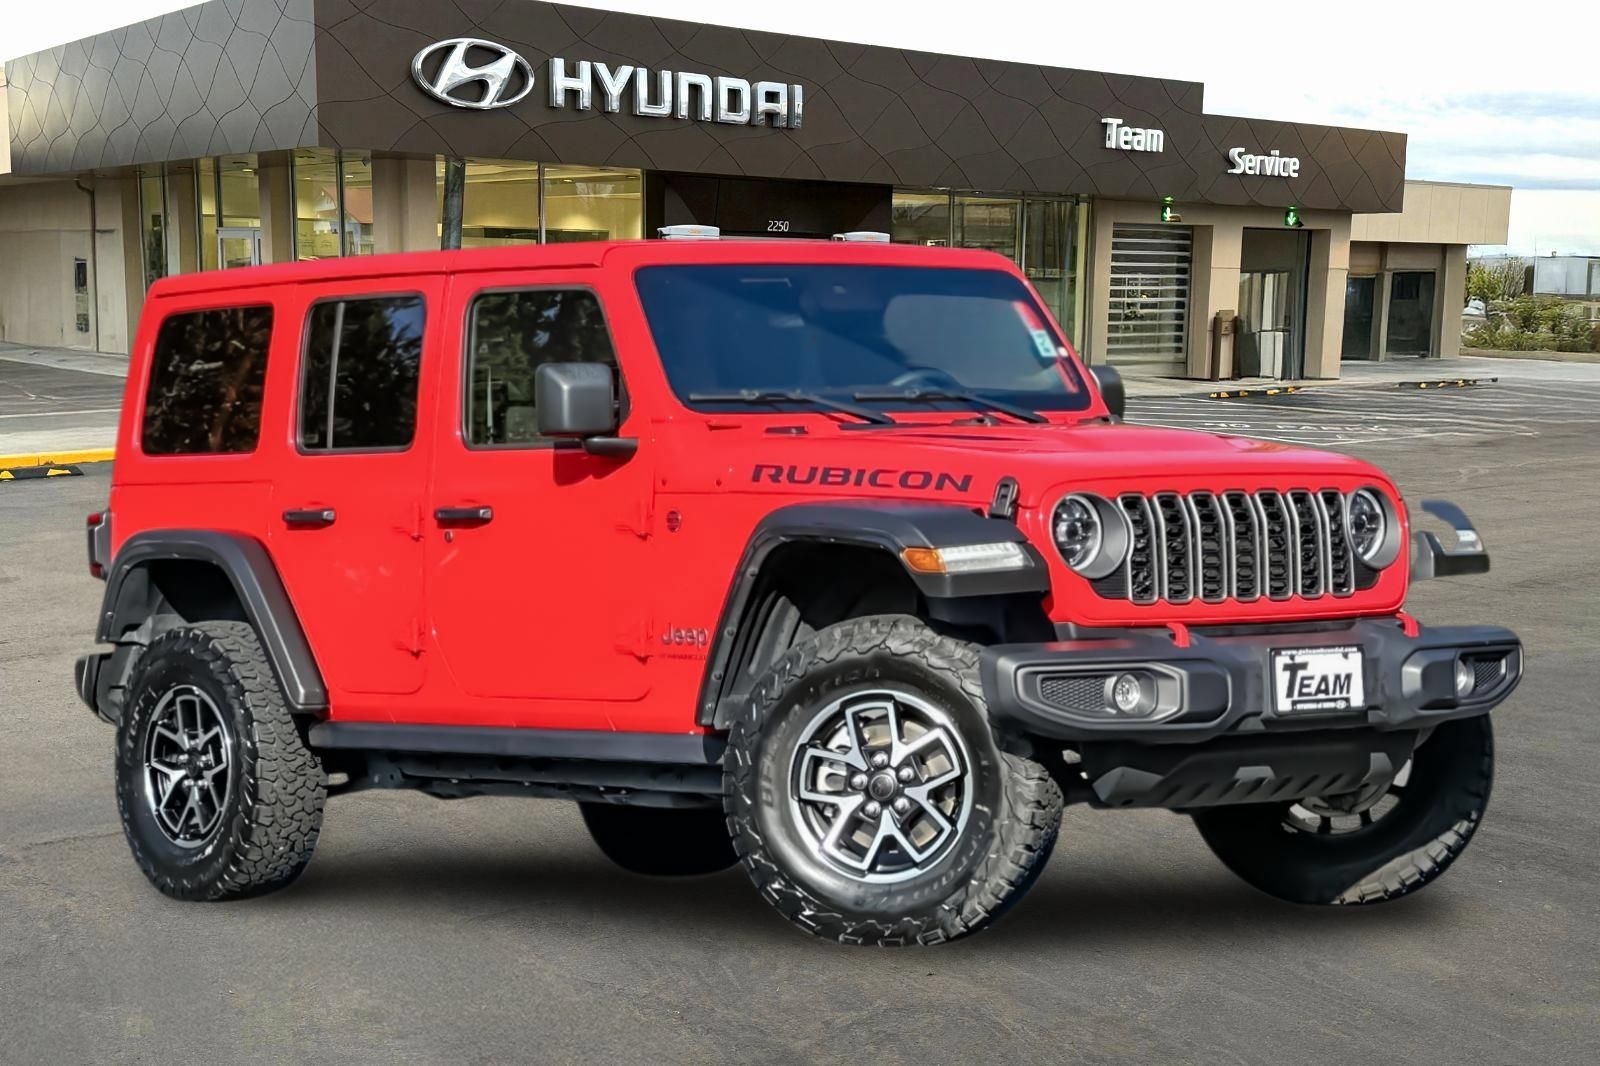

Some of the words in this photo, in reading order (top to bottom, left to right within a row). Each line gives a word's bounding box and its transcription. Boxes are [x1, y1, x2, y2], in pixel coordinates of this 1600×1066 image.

[548, 56, 804, 129] HYUNDAI
[1100, 116, 1165, 153] Team
[1227, 146, 1301, 178] Service
[766, 219, 790, 233] 2250
[751, 463, 973, 493] RUBICON
[662, 622, 709, 649] Jeep
[1282, 661, 1353, 699] TEAM
